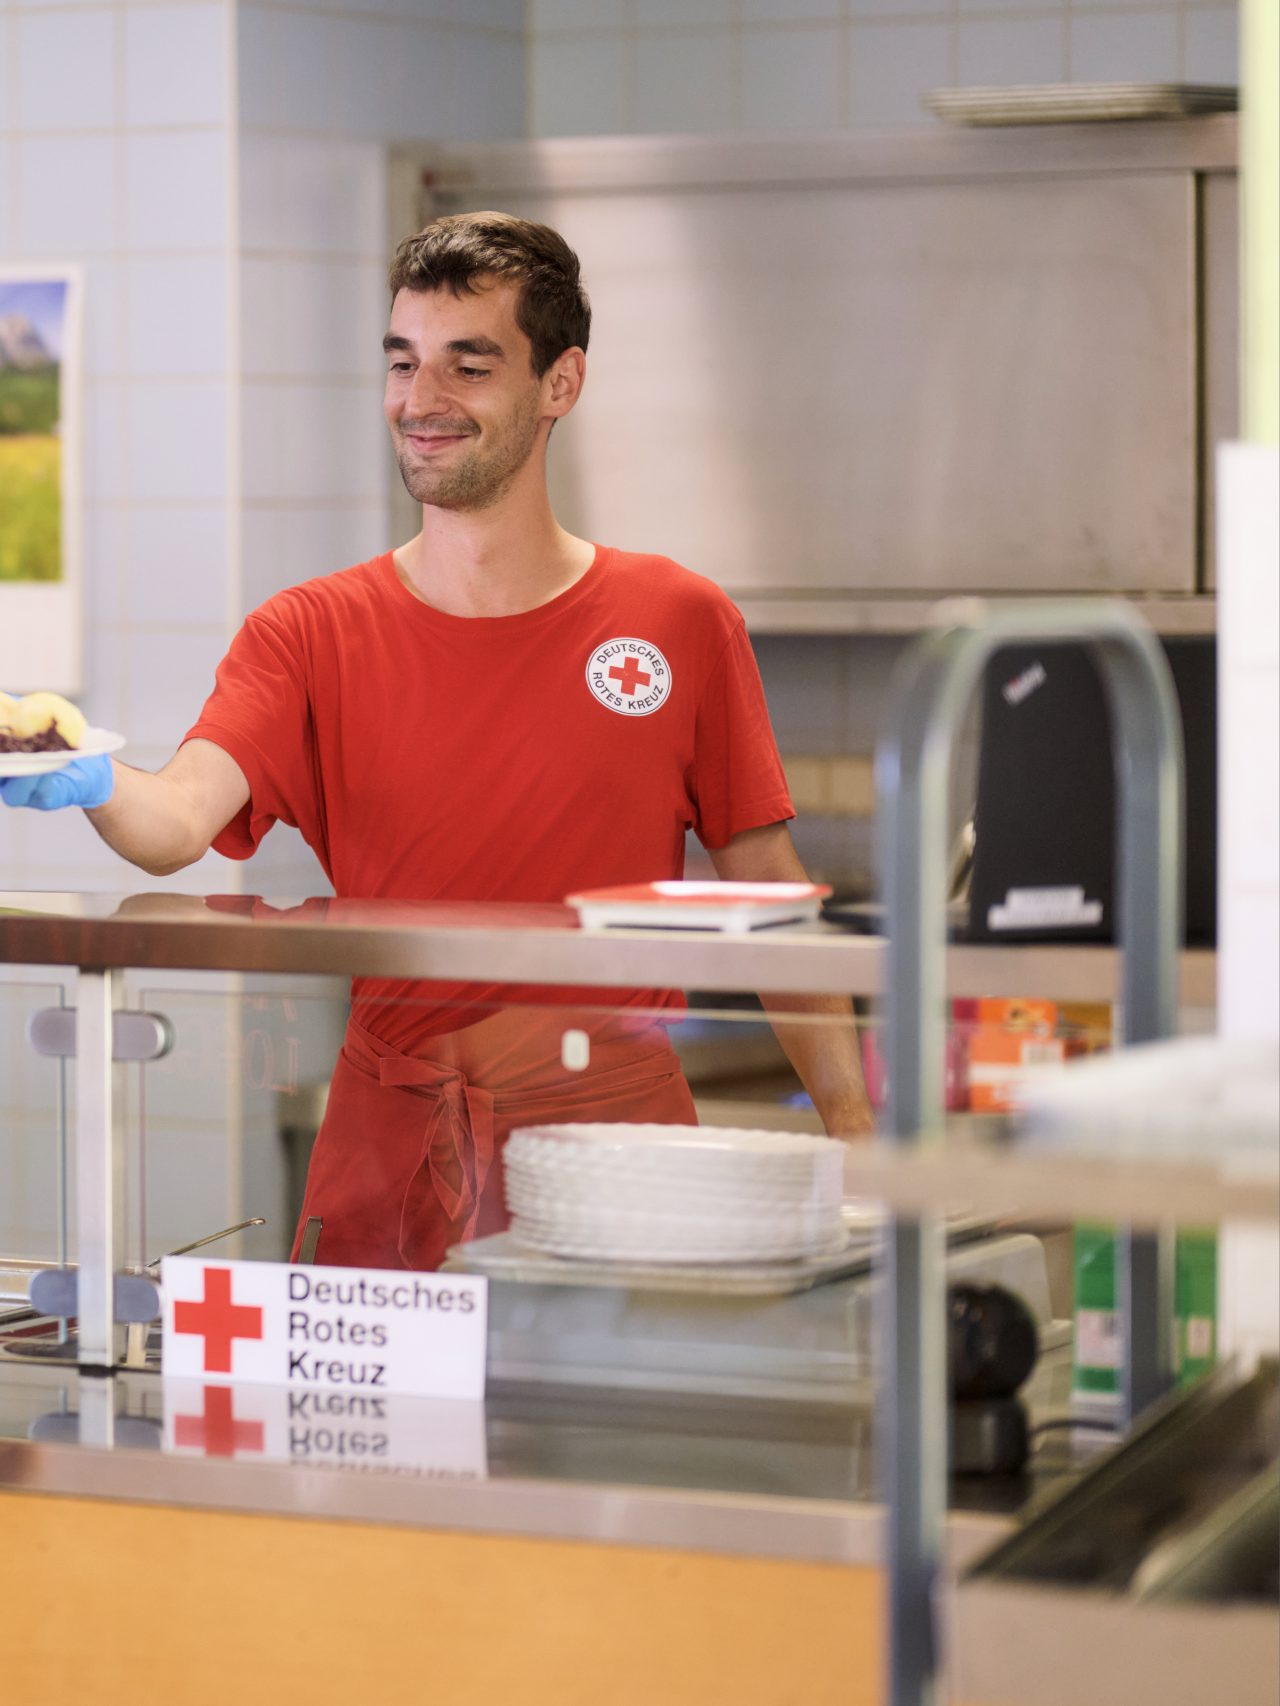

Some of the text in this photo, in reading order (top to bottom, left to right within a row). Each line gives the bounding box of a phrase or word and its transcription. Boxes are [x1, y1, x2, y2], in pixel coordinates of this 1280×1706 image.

[597, 643, 664, 676] DEUTSCHES
[593, 672, 664, 710] ROTES KREUZ
[288, 1272, 476, 1314] Deutsches
[288, 1311, 388, 1347] Rotes
[288, 1350, 388, 1386] Kreuz
